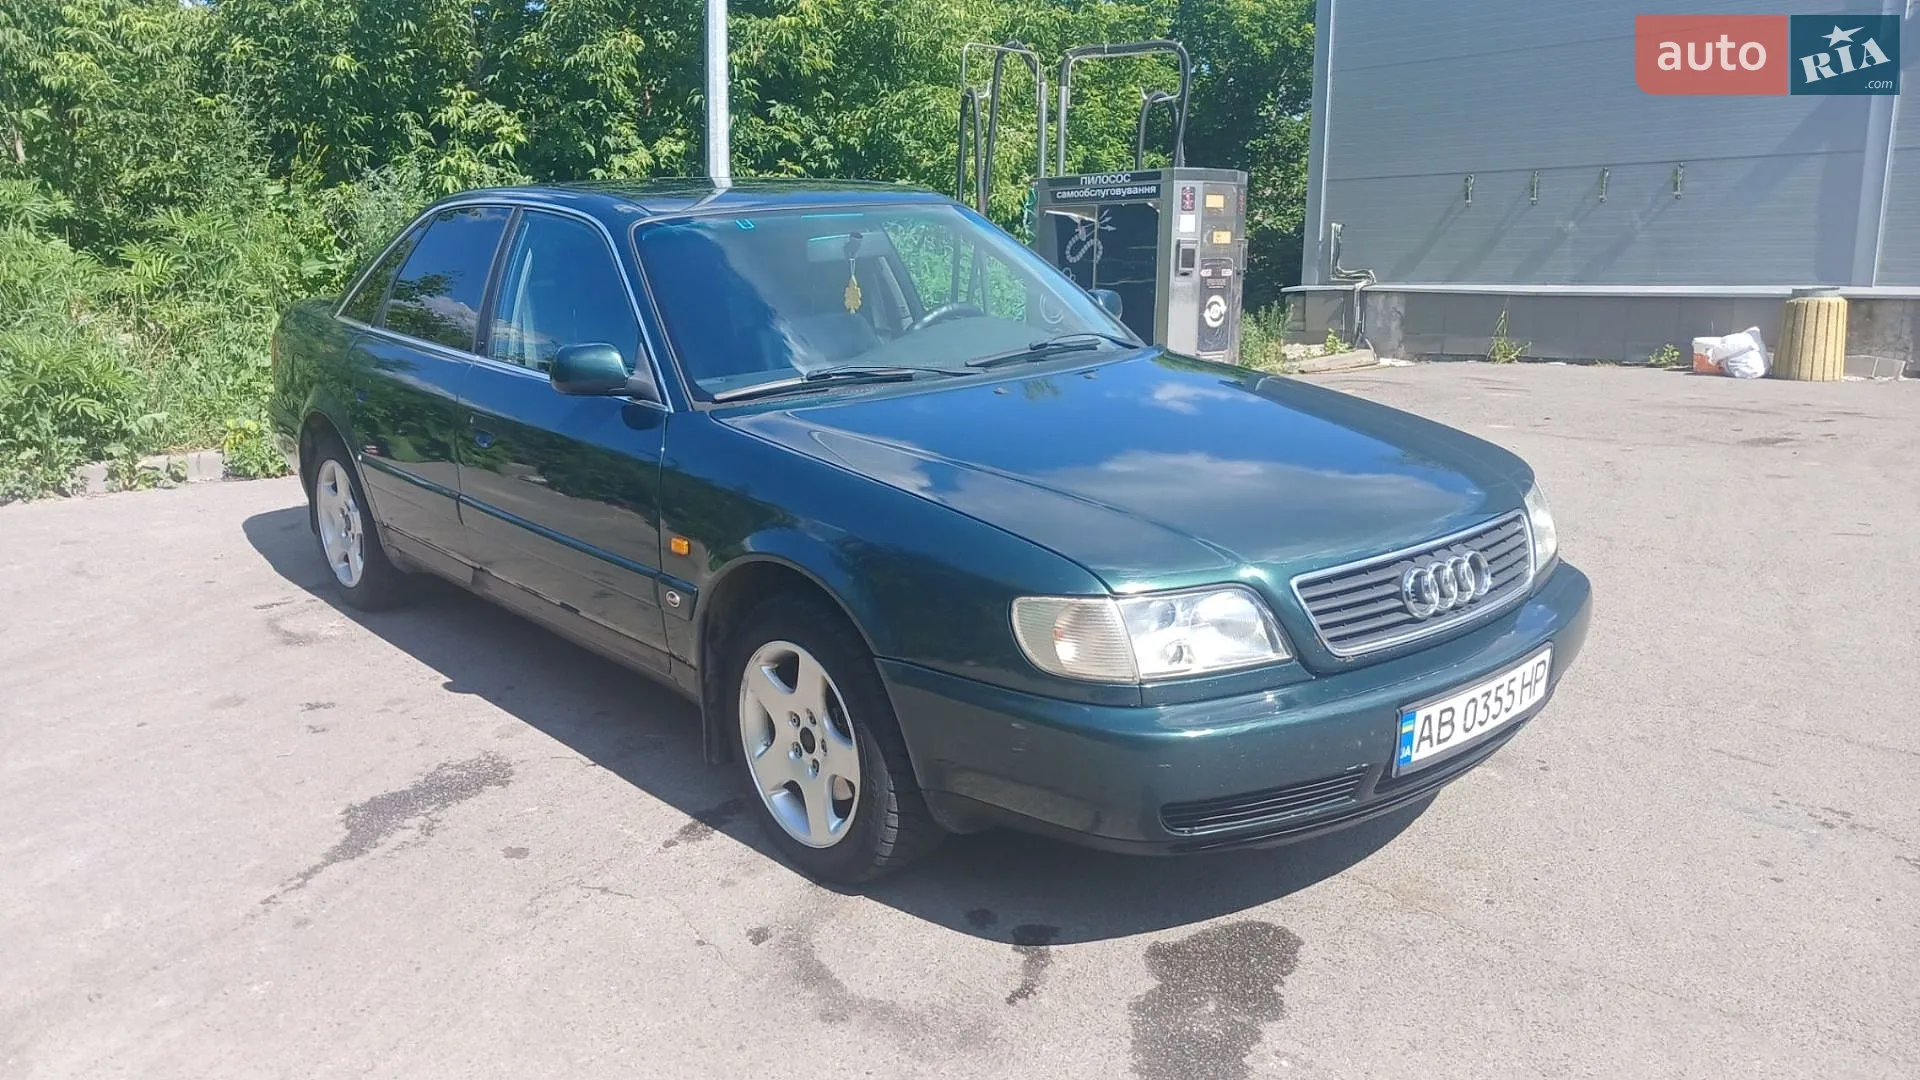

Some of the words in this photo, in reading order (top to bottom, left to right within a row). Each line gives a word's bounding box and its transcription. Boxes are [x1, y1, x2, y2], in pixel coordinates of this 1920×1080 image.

[1080, 173, 1132, 185] ПИЛОСОС
[1056, 186, 1157, 199] самообслуговування
[1415, 706, 1456, 754] AB
[1463, 676, 1517, 734] 0355
[1520, 659, 1547, 705] HP
